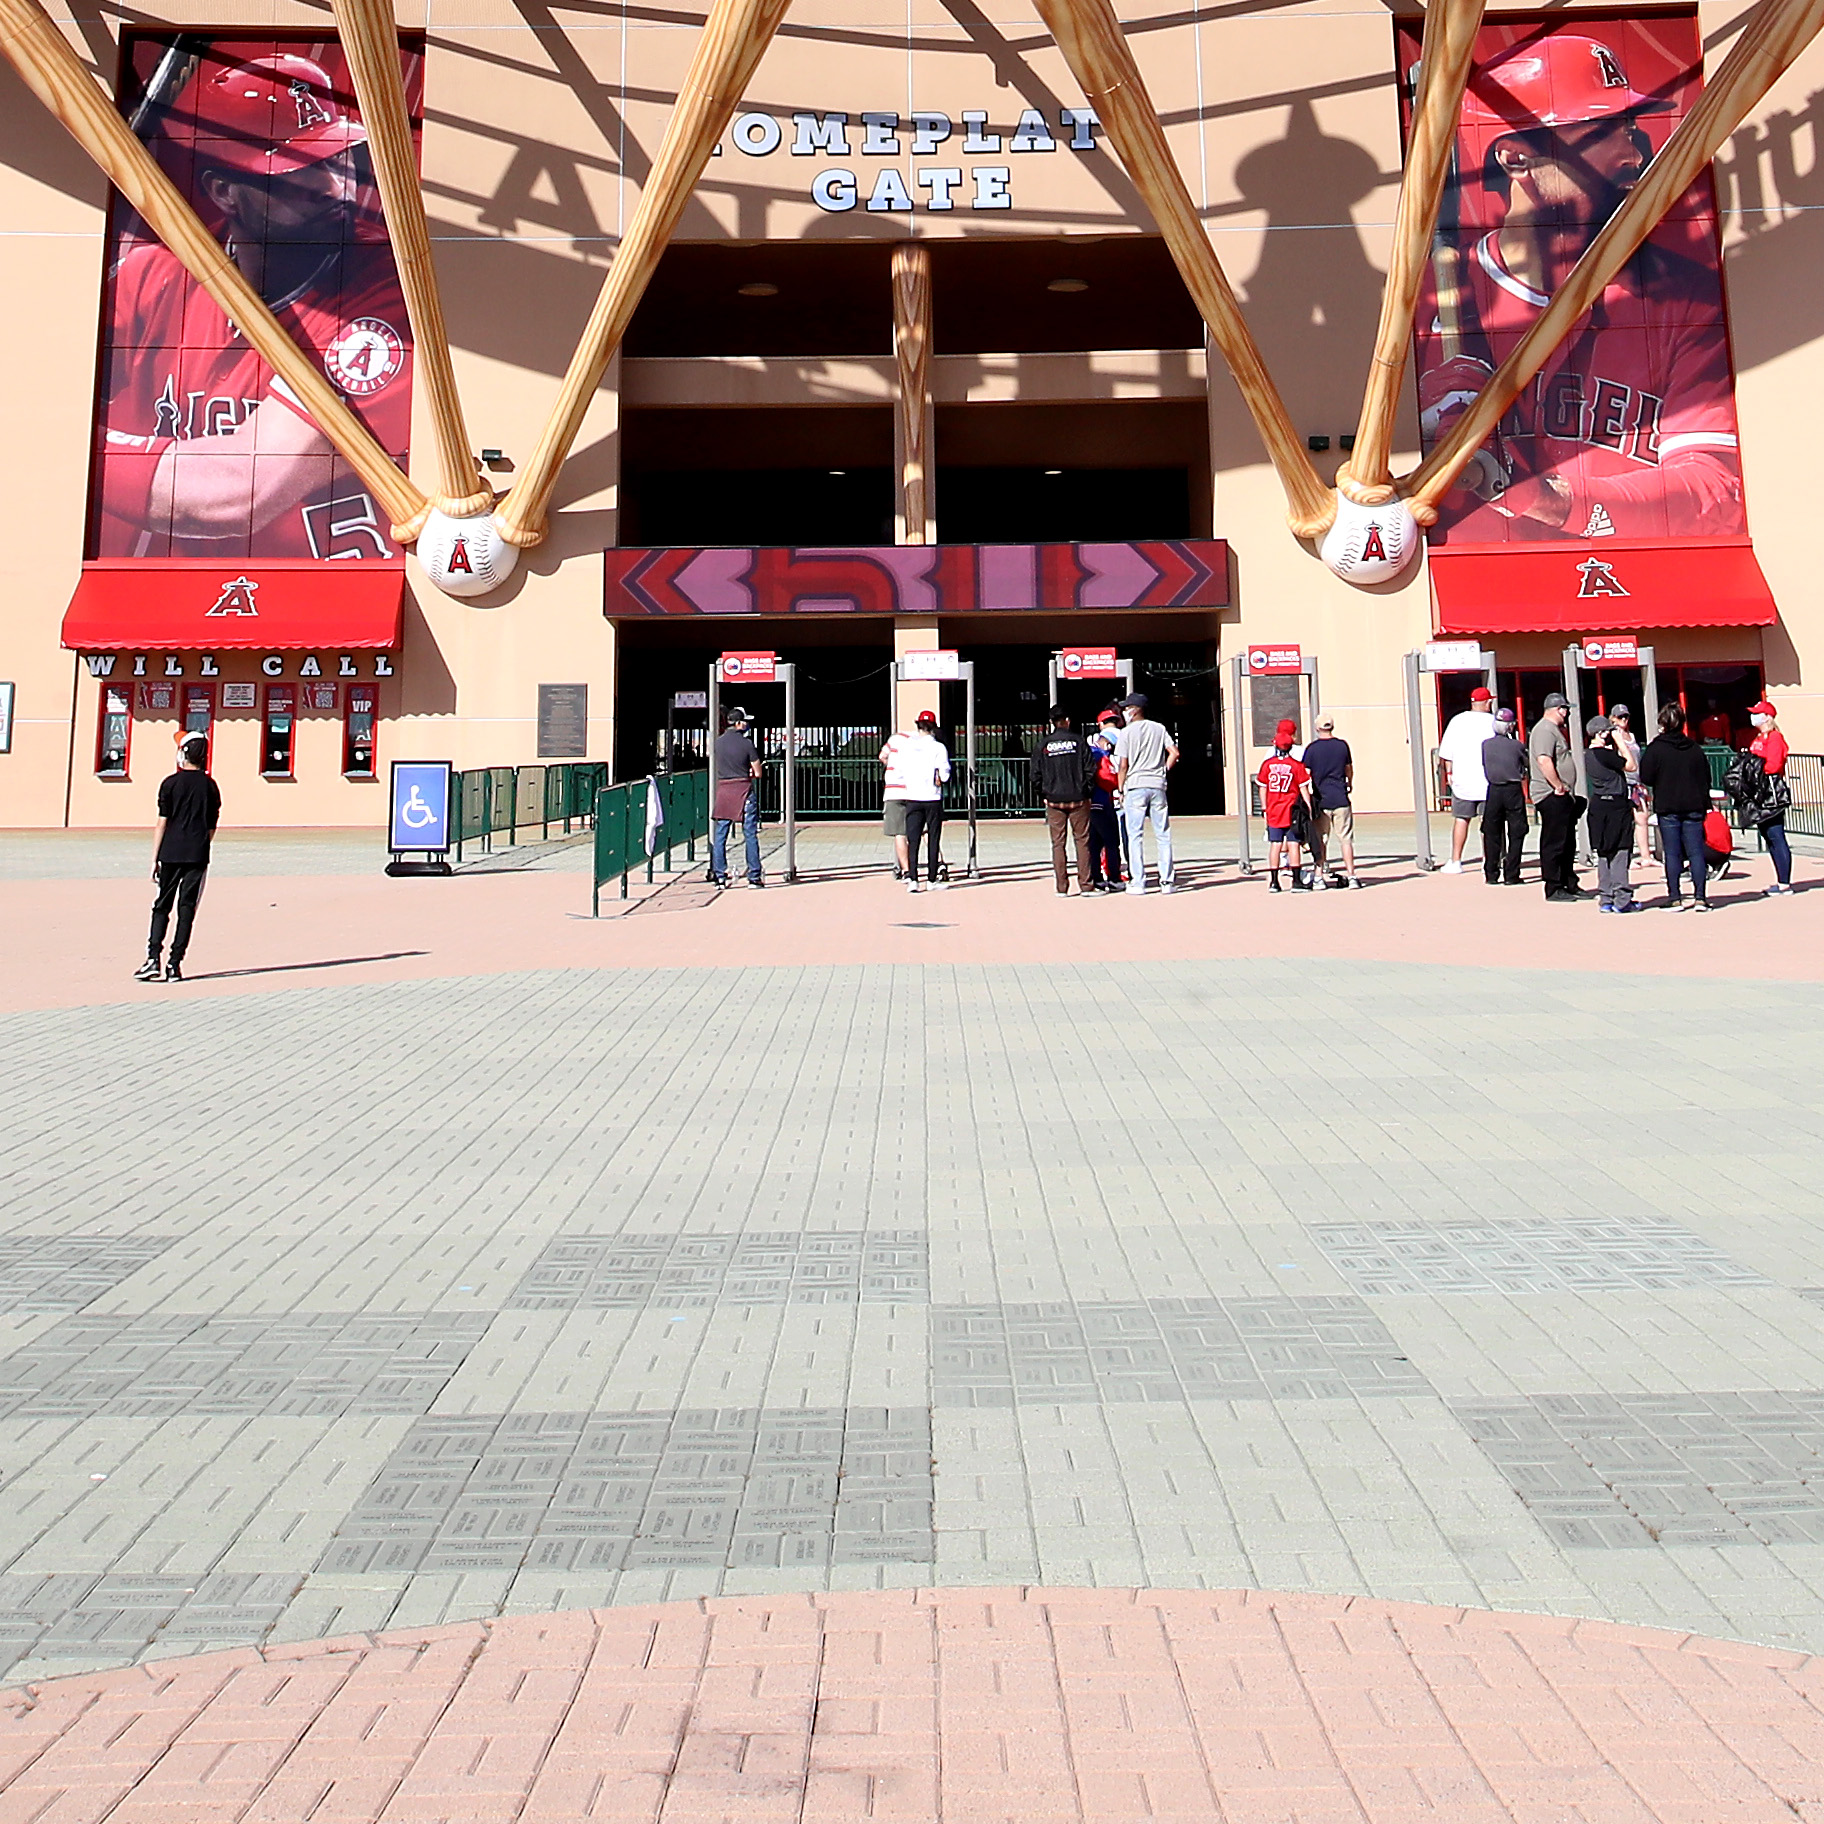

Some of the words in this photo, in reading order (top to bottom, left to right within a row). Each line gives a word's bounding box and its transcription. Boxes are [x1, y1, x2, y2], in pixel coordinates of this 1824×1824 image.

[713, 108, 1102, 157] OMEPLAT
[812, 166, 1012, 213] GATE
[1497, 370, 1664, 473] NGEL
[301, 492, 395, 561] 5
[1360, 519, 1388, 562] A
[447, 531, 475, 574] A
[204, 575, 260, 617] A
[1575, 556, 1632, 598] A
[86, 654, 220, 677] WILL
[261, 654, 394, 677] CALL
[352, 700, 373, 713] VIP
[1268, 772, 1293, 793] 27
